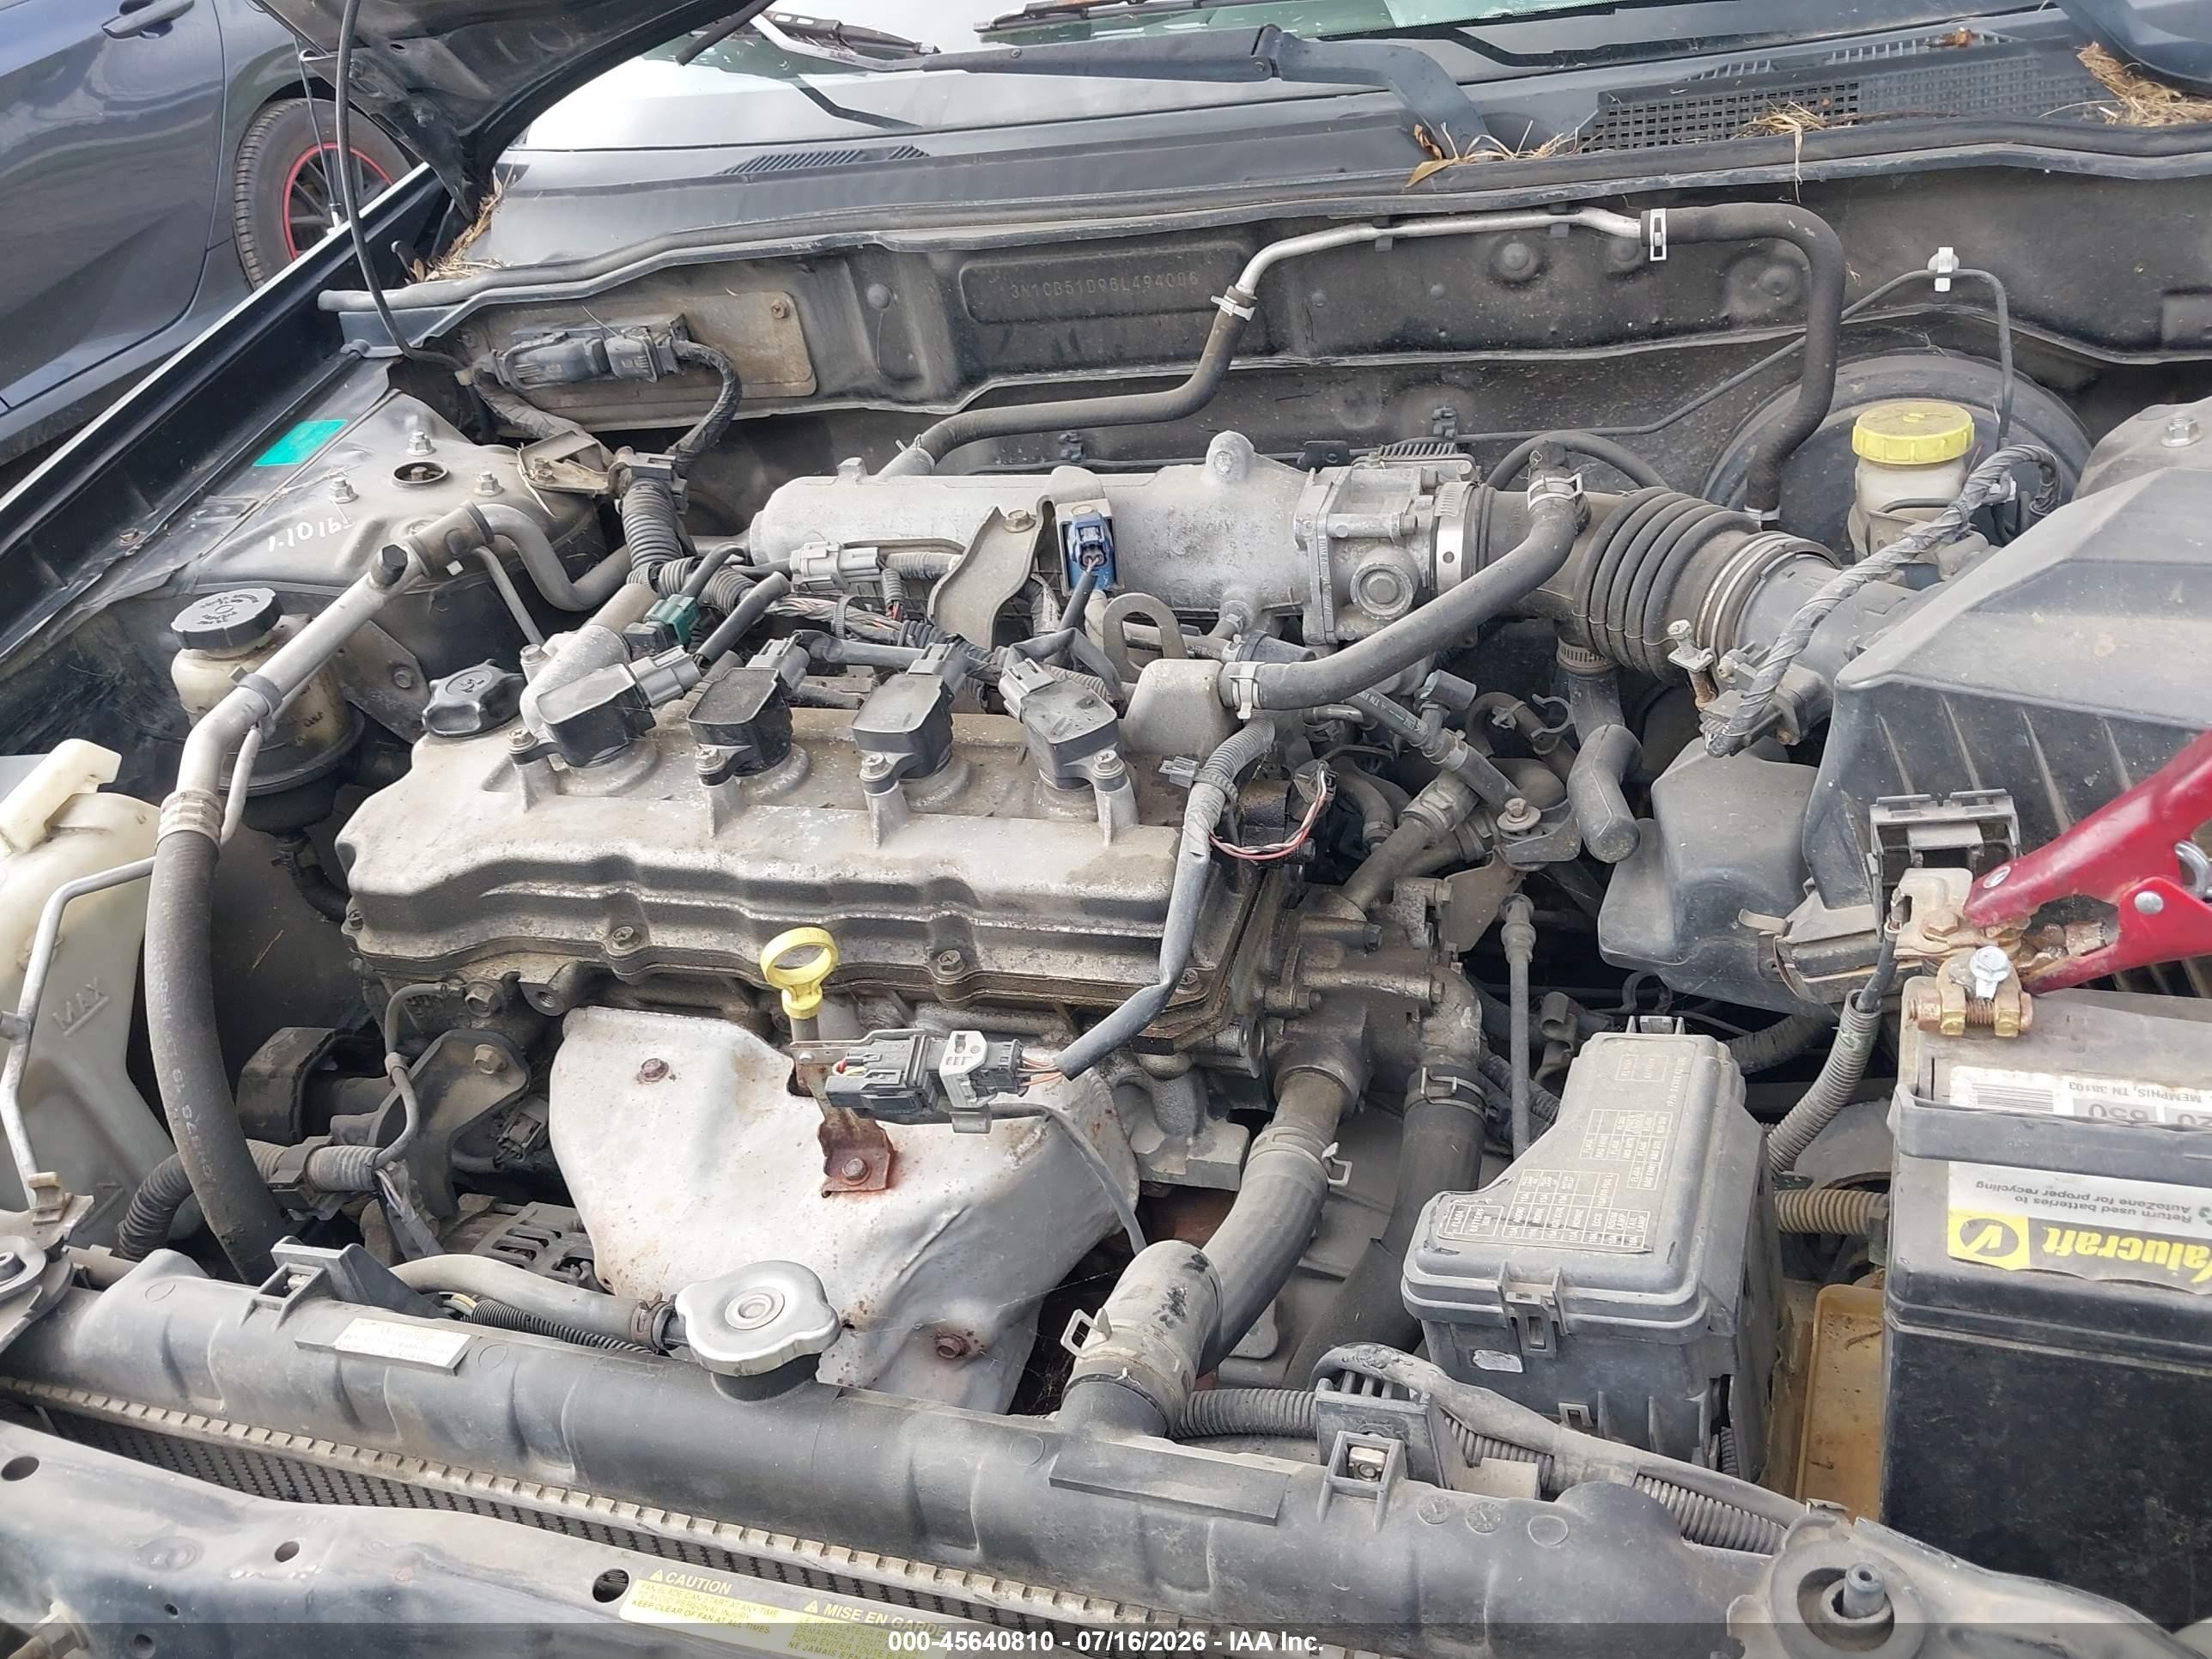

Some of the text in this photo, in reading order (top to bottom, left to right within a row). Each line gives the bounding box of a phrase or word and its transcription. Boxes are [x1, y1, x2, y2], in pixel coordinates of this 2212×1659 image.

[52, 976, 106, 1030] MAX
[2112, 1087, 2130, 1097] TN
[2133, 1086, 2203, 1103] MEMPHIS,
[1976, 1182, 2191, 1213] AutoZone for proper recycling
[2014, 1195, 2192, 1224] Return used batteries to
[665, 1571, 733, 1595] CAUTION
[631, 1600, 654, 1608] KEEP
[654, 1603, 684, 1613] CLEAR
[696, 1611, 714, 1621] FAN
[745, 1622, 770, 1634] TIMES
[758, 1607, 780, 1616] TIME
[823, 1602, 864, 1623] MISE
[864, 1611, 890, 1626] EN
[890, 1616, 950, 1638] GARDE
[787, 1641, 800, 1650] NE
[802, 1645, 837, 1657] JAMAIS
